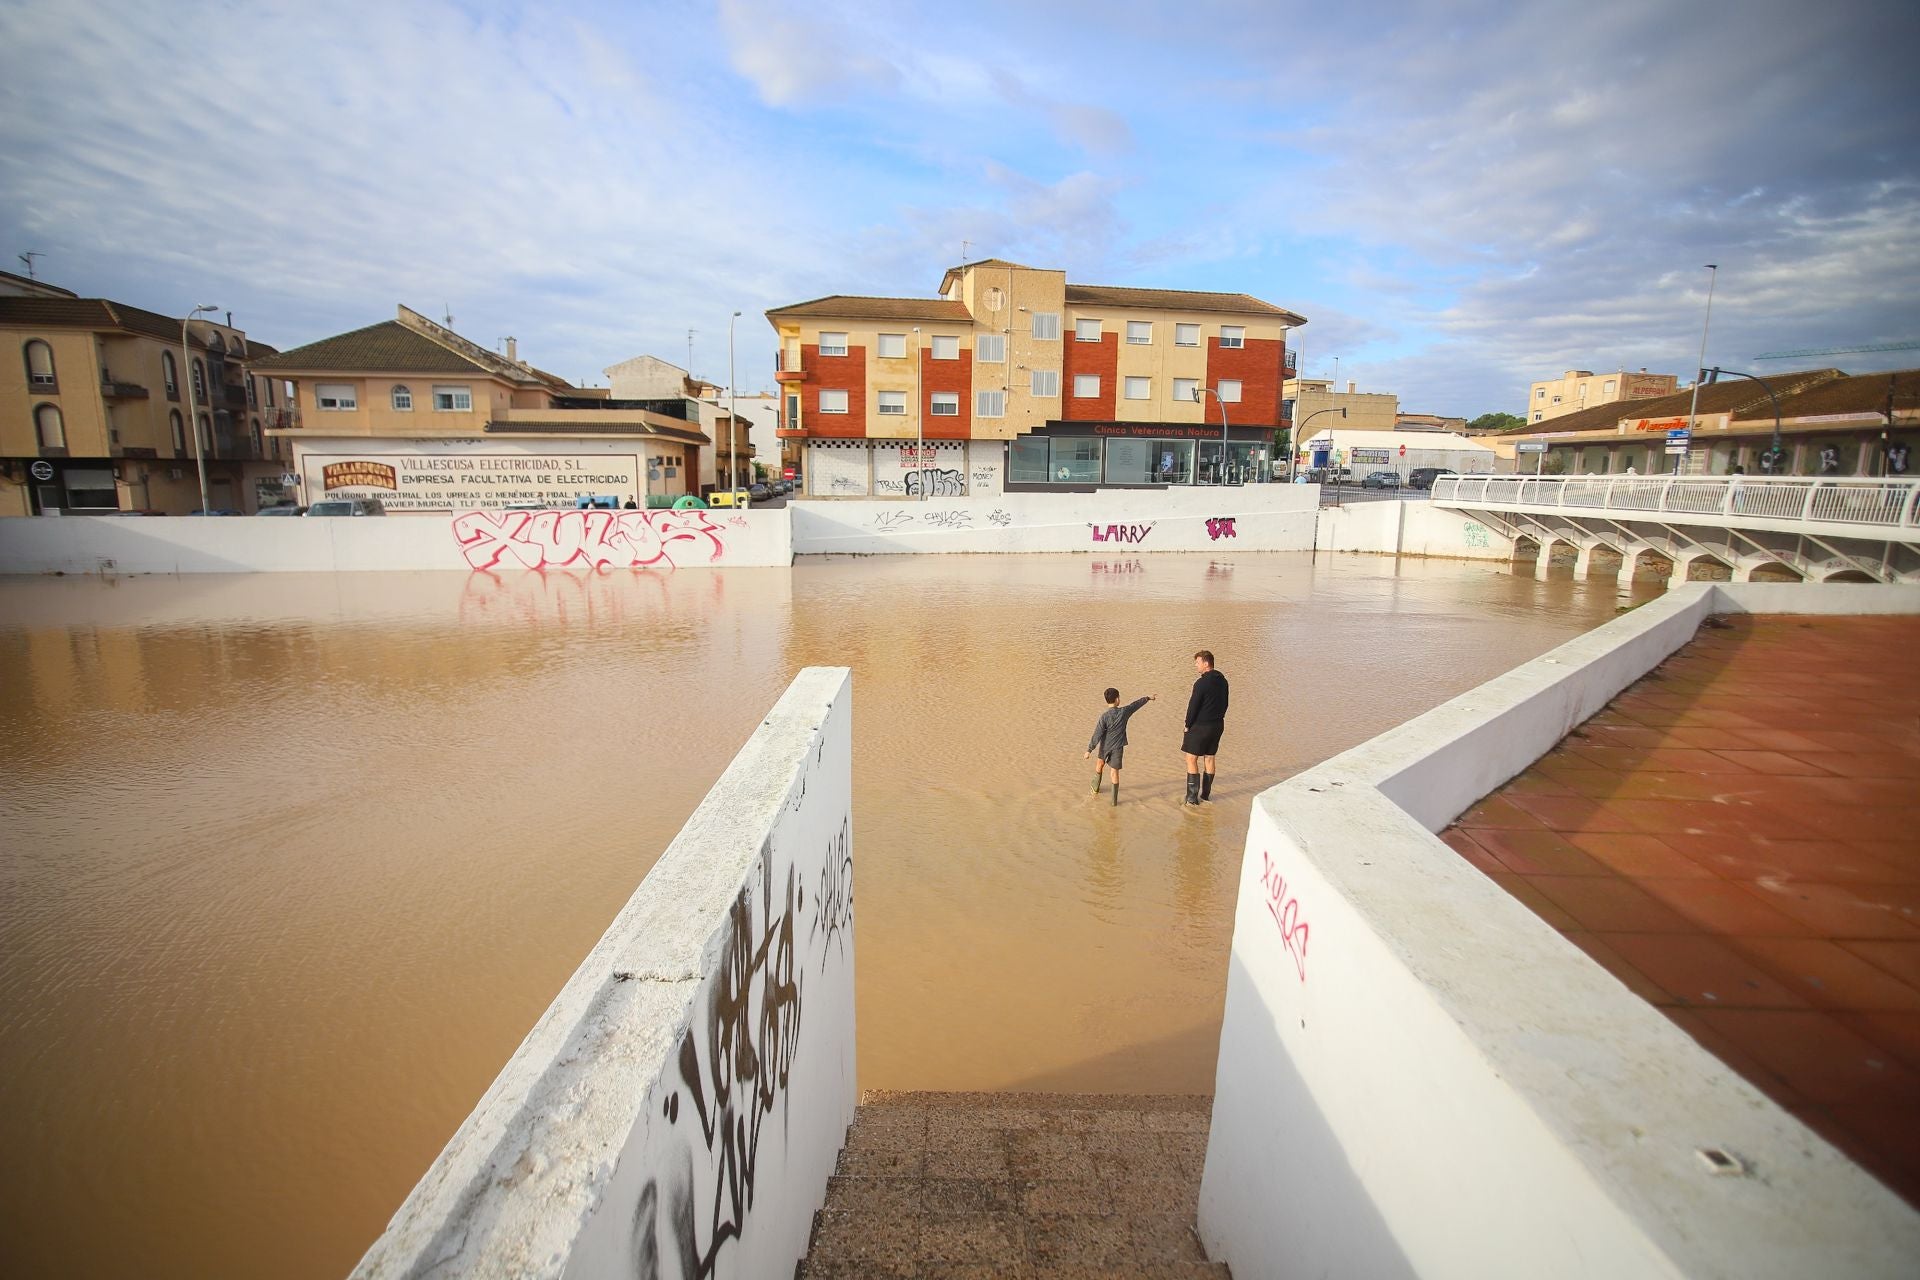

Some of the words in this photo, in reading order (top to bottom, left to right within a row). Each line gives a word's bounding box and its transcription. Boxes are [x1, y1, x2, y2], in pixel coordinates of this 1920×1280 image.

[1131, 426, 1184, 437] Veterinaria
[400, 458, 475, 470] VILLAESCUSA
[480, 459, 561, 472] ELECTRICIDAD,
[402, 475, 455, 484] EMPRESA
[461, 474, 532, 484] FACULTATIVA
[537, 475, 552, 484] DE
[557, 475, 628, 484] ELECTRICIDAD
